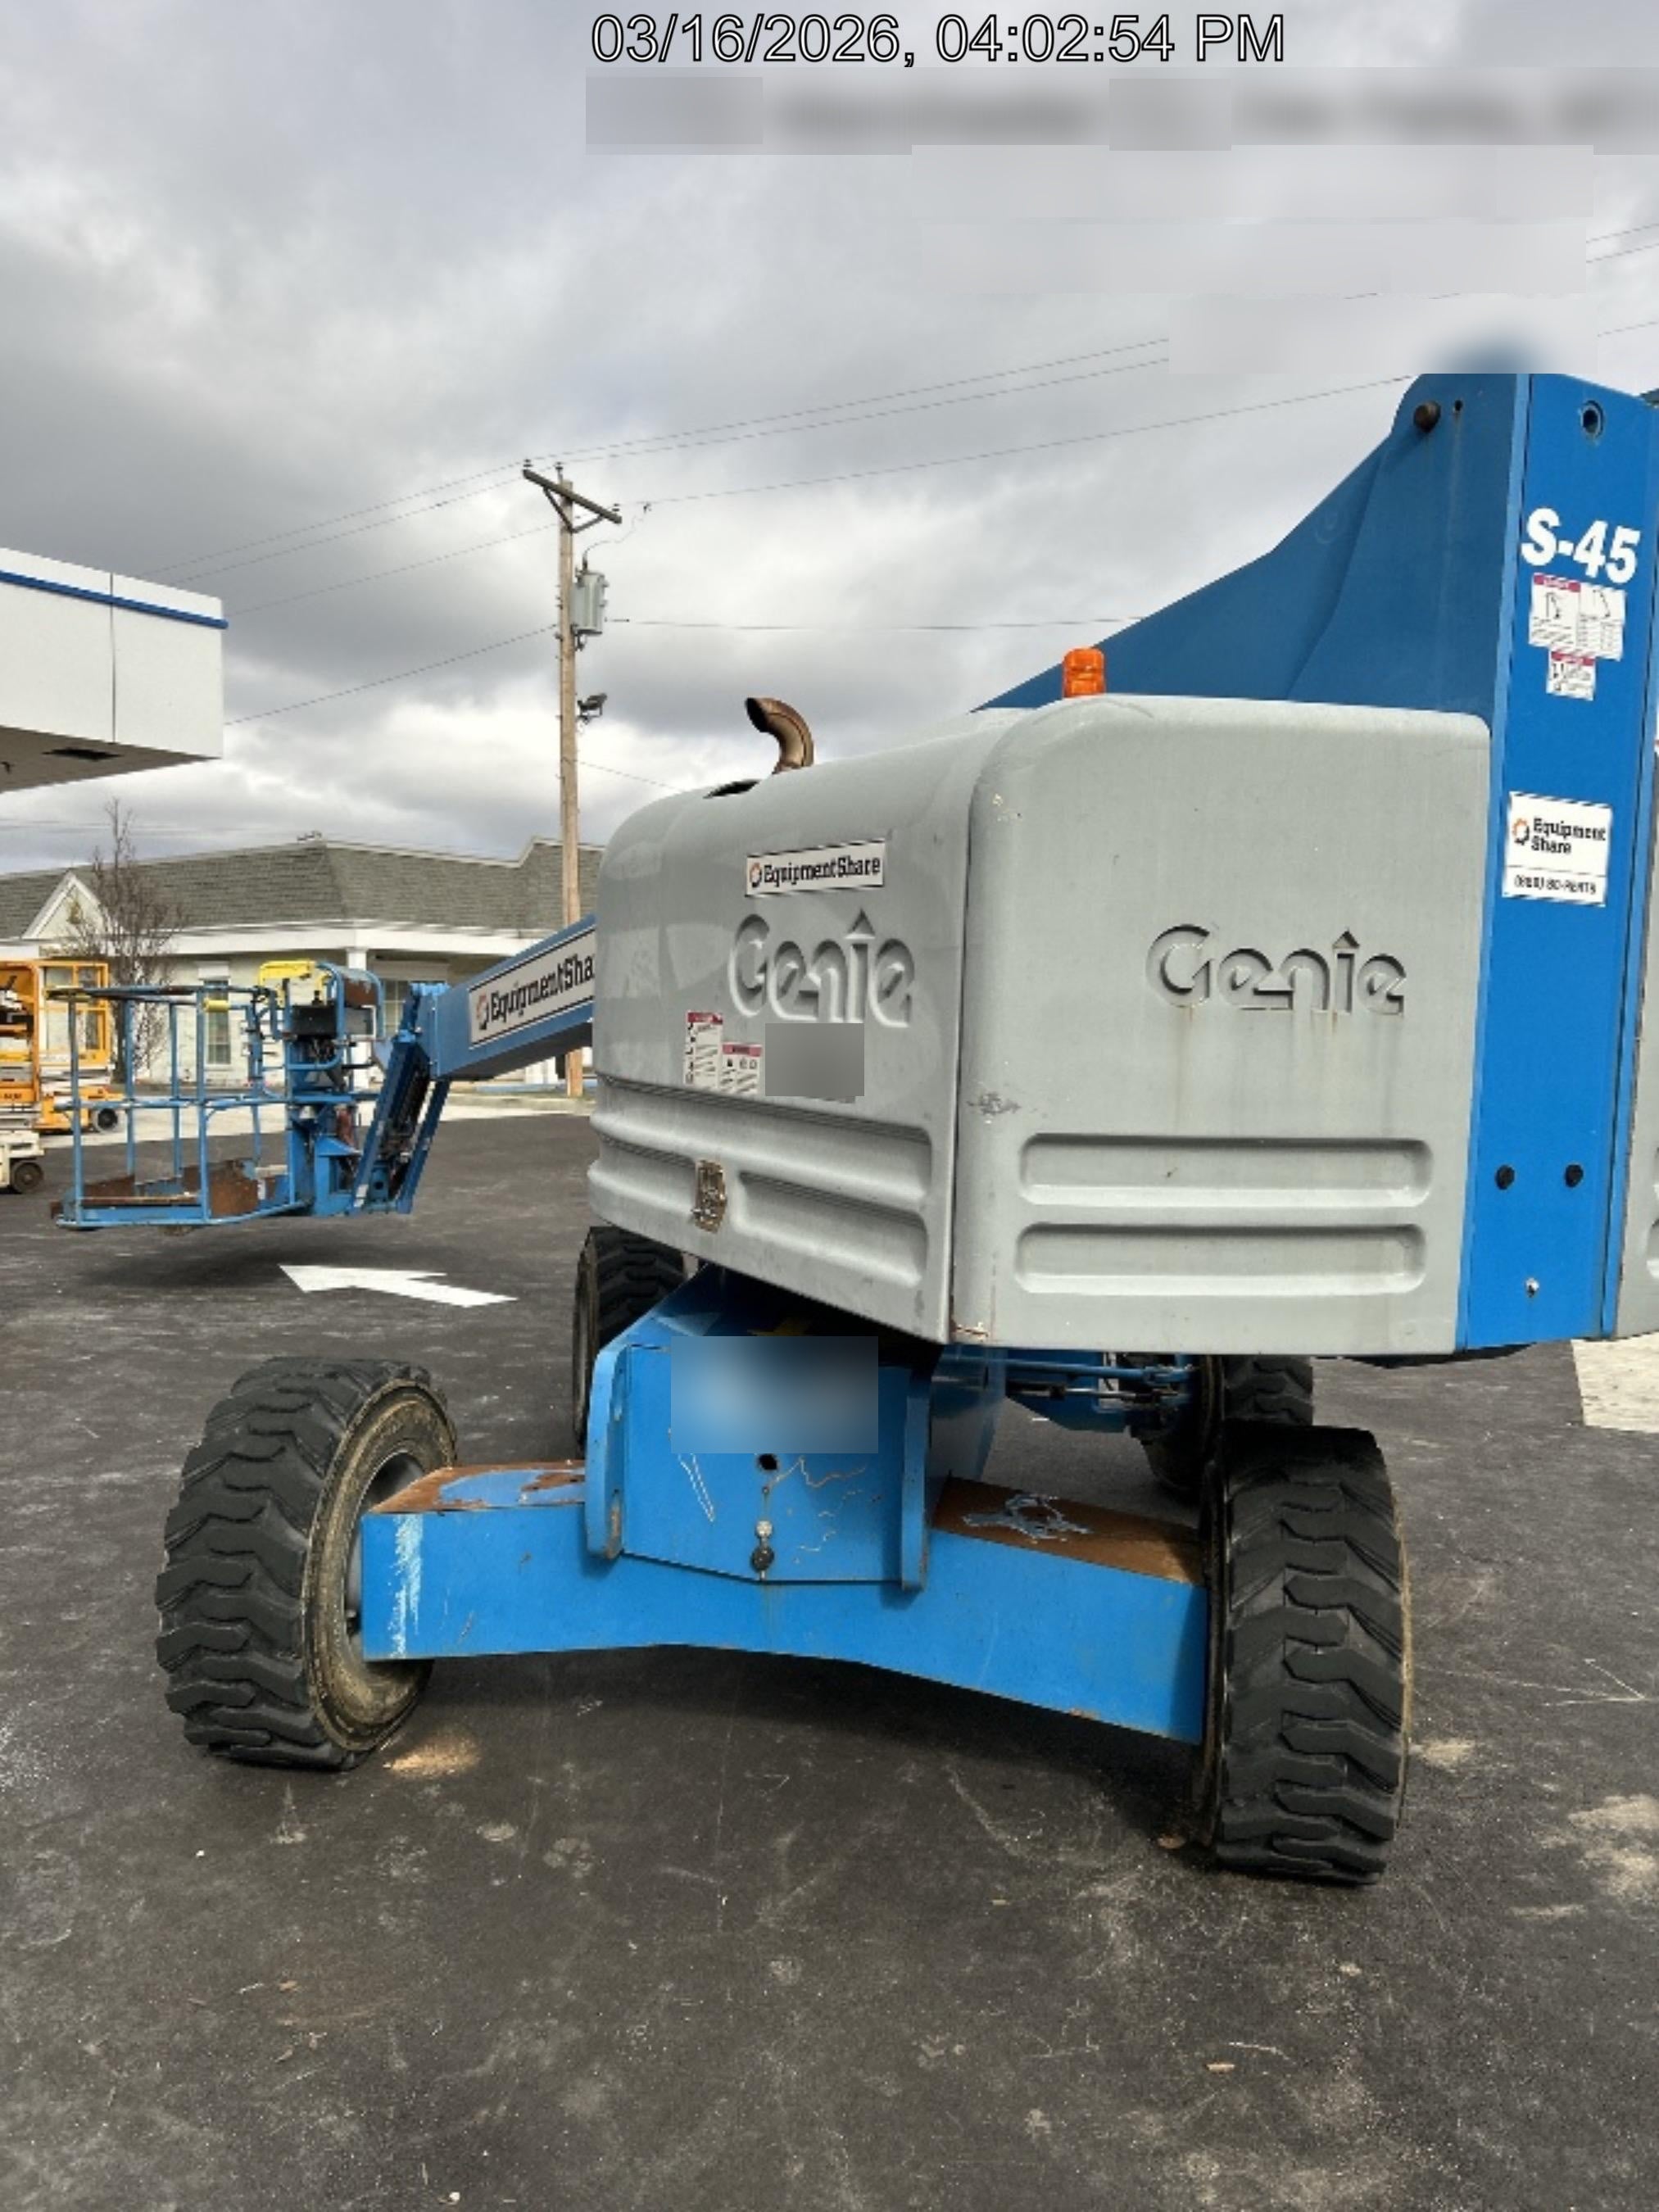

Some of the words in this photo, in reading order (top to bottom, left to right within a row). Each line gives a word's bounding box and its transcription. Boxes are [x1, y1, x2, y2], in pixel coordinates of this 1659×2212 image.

[1521, 506, 1640, 584] S-45
[1530, 835, 1572, 854] Share
[1533, 817, 1607, 841] Equipment
[763, 855, 882, 886] EquipmentShare
[491, 953, 596, 1023] EquipmentSha
[728, 908, 915, 1028] Genie
[1145, 923, 1407, 1016] Genie
